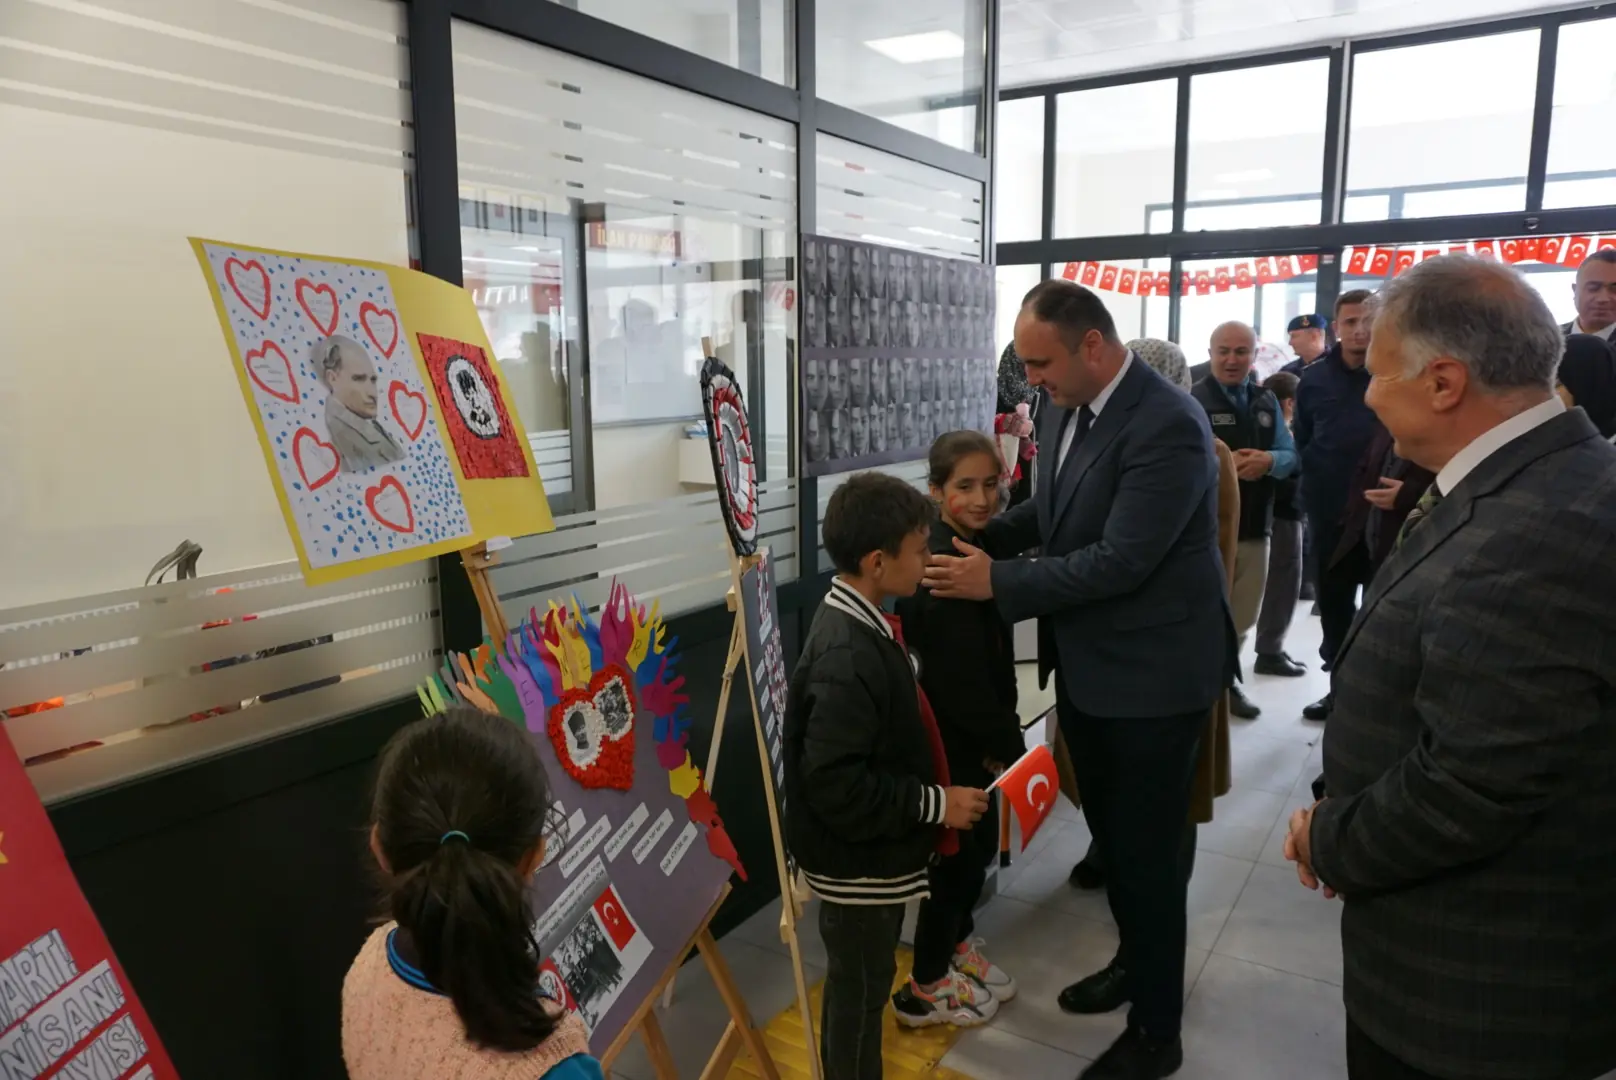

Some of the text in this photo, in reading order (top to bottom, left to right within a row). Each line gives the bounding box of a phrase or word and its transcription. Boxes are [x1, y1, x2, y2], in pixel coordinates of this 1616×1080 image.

[597, 223, 626, 248] İLAN
[0, 928, 79, 1031] ART!
[55, 1014, 148, 1080] YIS!
